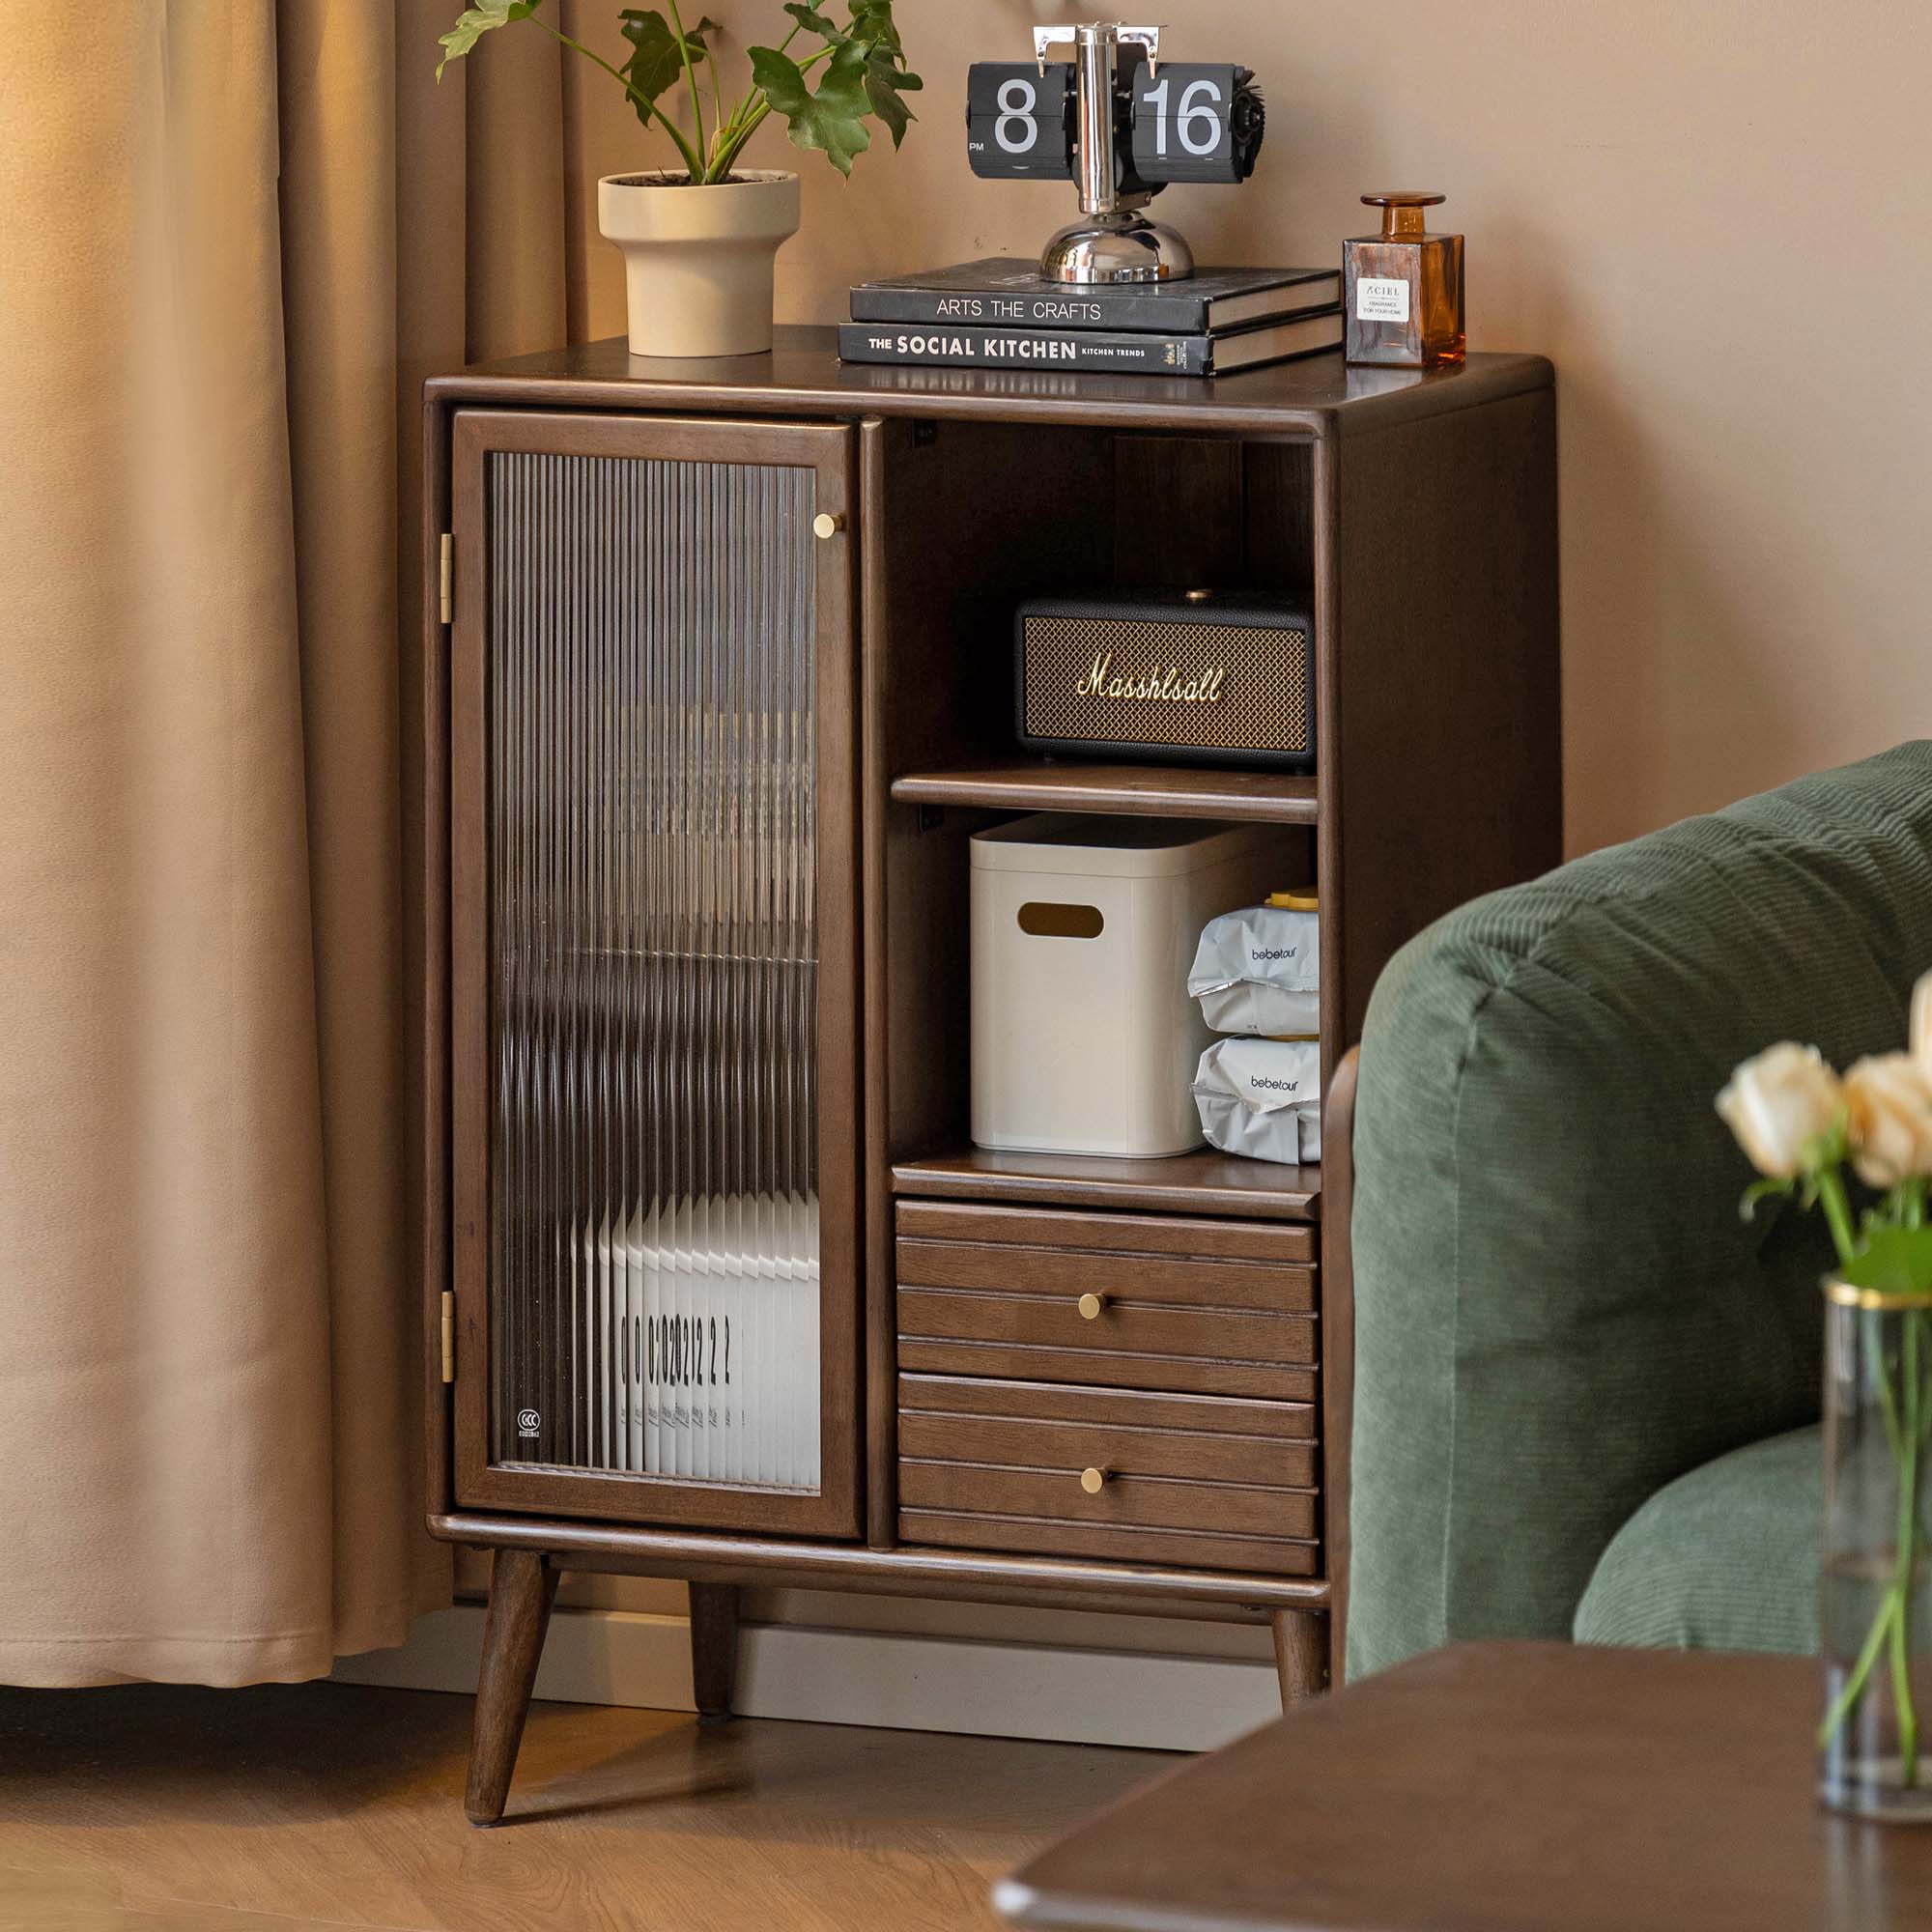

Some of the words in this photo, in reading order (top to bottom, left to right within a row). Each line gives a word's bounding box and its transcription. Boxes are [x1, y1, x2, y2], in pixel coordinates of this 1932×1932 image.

[994, 78, 1038, 154] 8
[1143, 78, 1222, 156] 16
[969, 142, 984, 152] PM
[936, 298, 982, 317] ARTS
[990, 299, 1025, 319] THE
[1032, 301, 1102, 321] CRAFTS
[867, 337, 893, 351] THE
[896, 335, 974, 356] SOCIAL
[983, 338, 1077, 360] KITCHEN
[1081, 347, 1115, 356] KITCHEN
[1116, 348, 1146, 357] TRENDS
[1251, 947, 1298, 961] bebetour
[1250, 1075, 1299, 1092] bebetour
